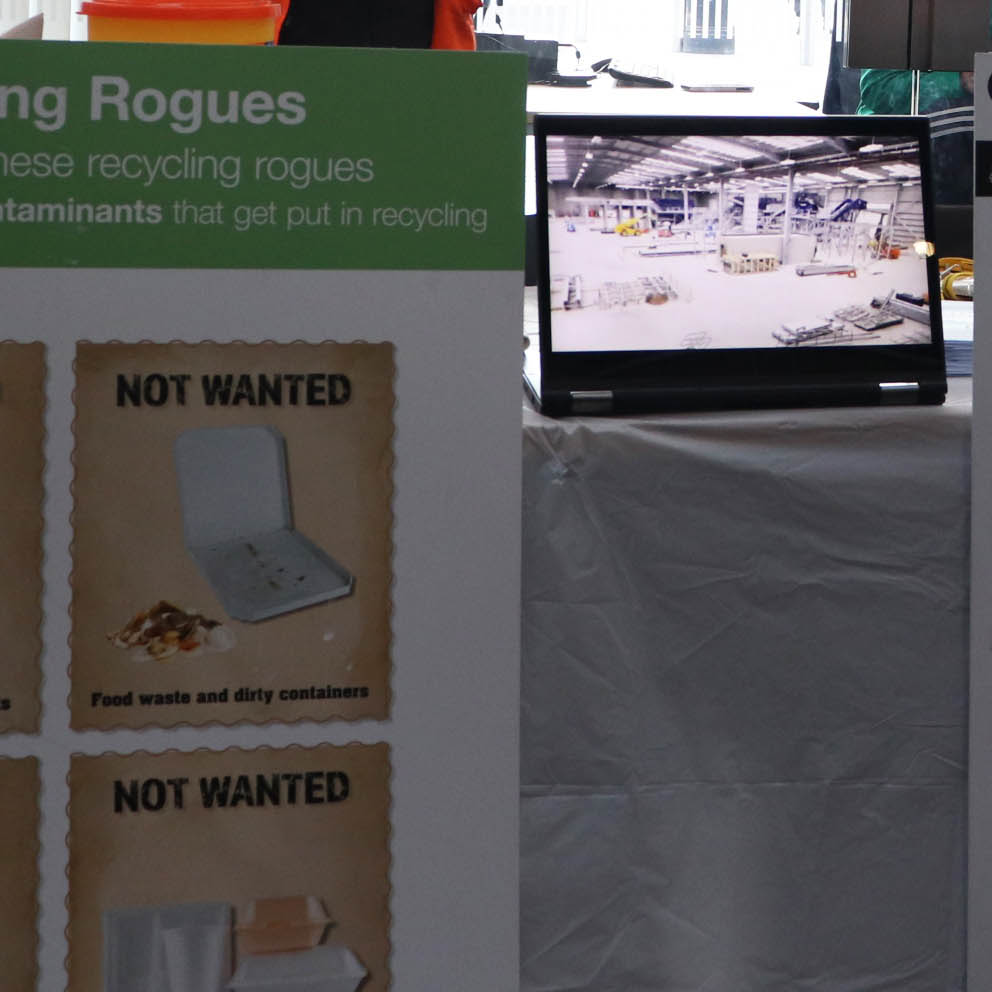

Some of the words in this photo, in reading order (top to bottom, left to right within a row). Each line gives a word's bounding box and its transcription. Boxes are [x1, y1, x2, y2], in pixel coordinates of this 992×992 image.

[0, 85, 66, 132] ng
[90, 75, 307, 133] Rogues
[88, 147, 240, 188] recycling
[255, 155, 374, 188] rogues
[174, 200, 224, 225] that
[234, 202, 276, 231] get
[287, 202, 331, 231] put
[341, 201, 363, 225] in
[373, 202, 488, 233] recycling
[116, 373, 192, 407] NOT
[201, 373, 353, 407] WANTED
[91, 691, 133, 707] Food
[140, 691, 190, 706] waste
[196, 687, 228, 704] and
[234, 685, 274, 705] dirty
[279, 684, 370, 702] containers
[113, 776, 189, 814] NOT
[199, 771, 350, 810] WANTED
